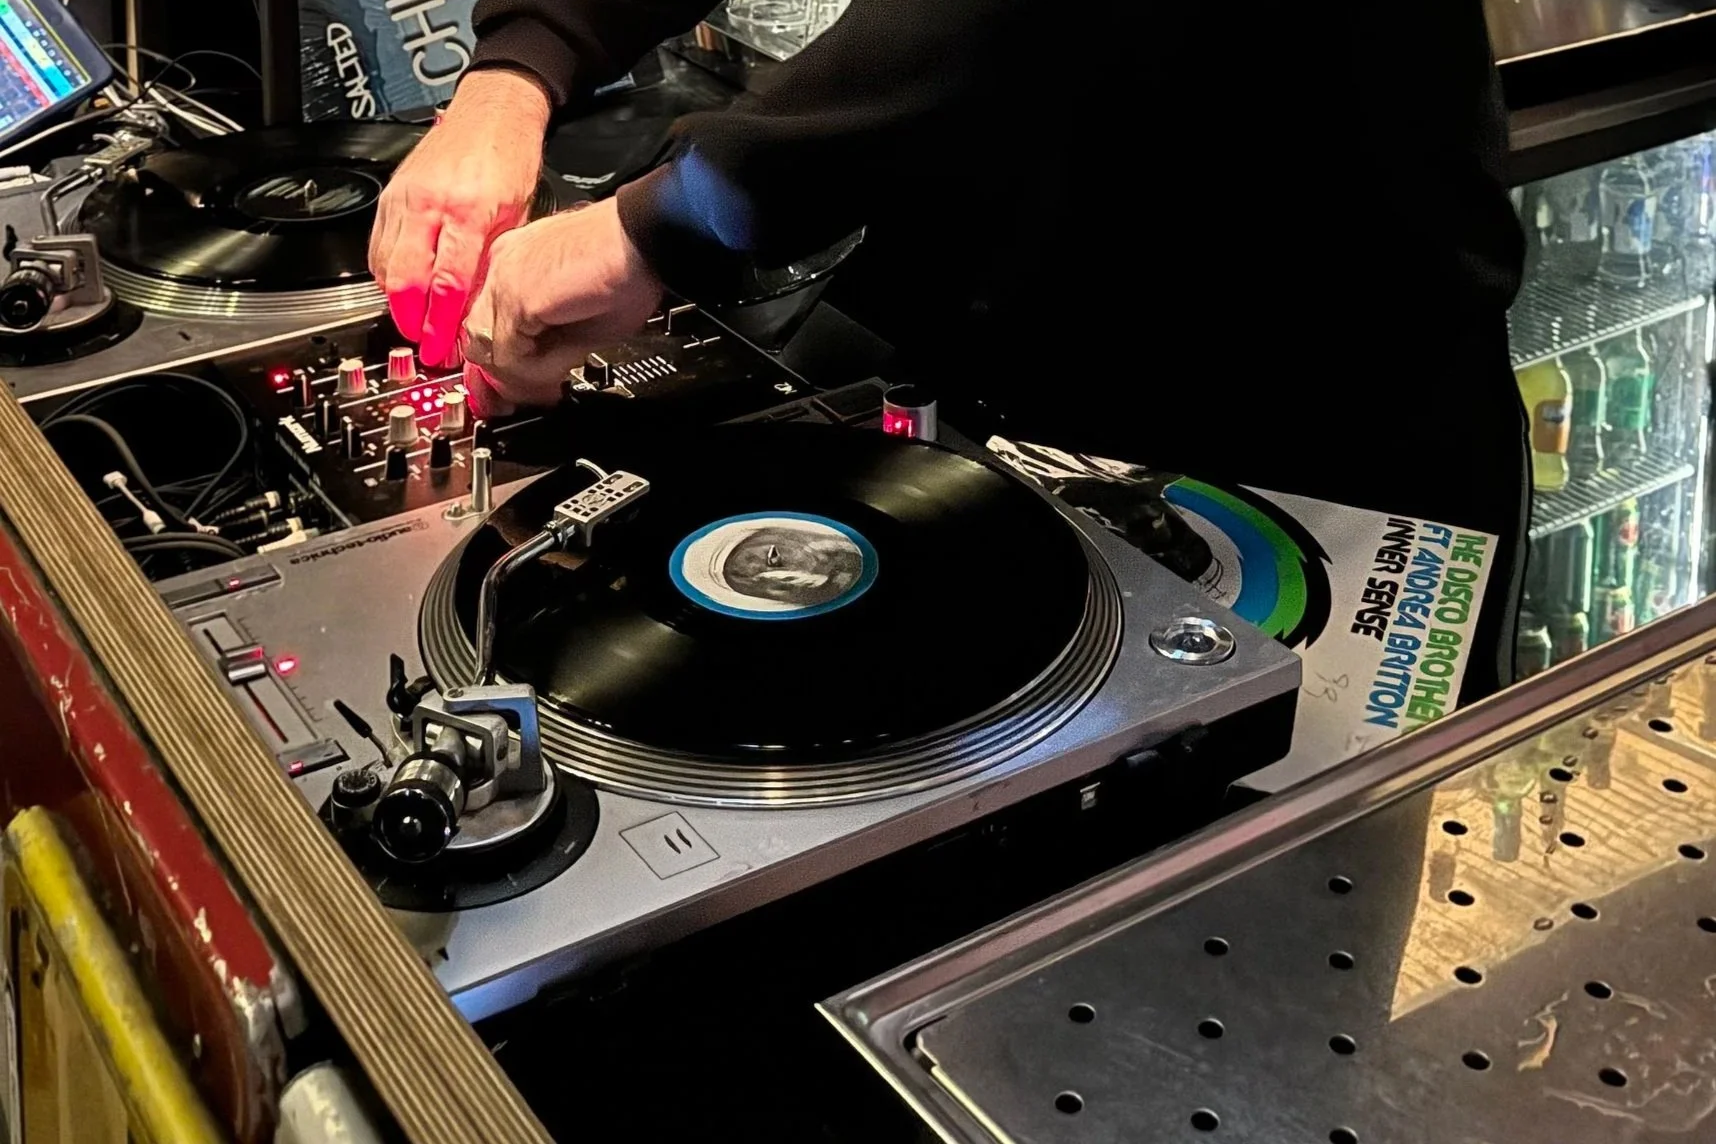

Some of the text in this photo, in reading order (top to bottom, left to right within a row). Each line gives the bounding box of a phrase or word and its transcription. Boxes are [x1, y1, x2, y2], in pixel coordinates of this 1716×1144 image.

[326, 22, 377, 119] SALTED
[289, 525, 413, 566] audio-technica
[1350, 517, 1417, 643] INNER SENSE
[1449, 533, 1488, 569] THE
[1363, 523, 1454, 730] FT ANDREA BRITTON
[1433, 566, 1479, 626] DISCO
